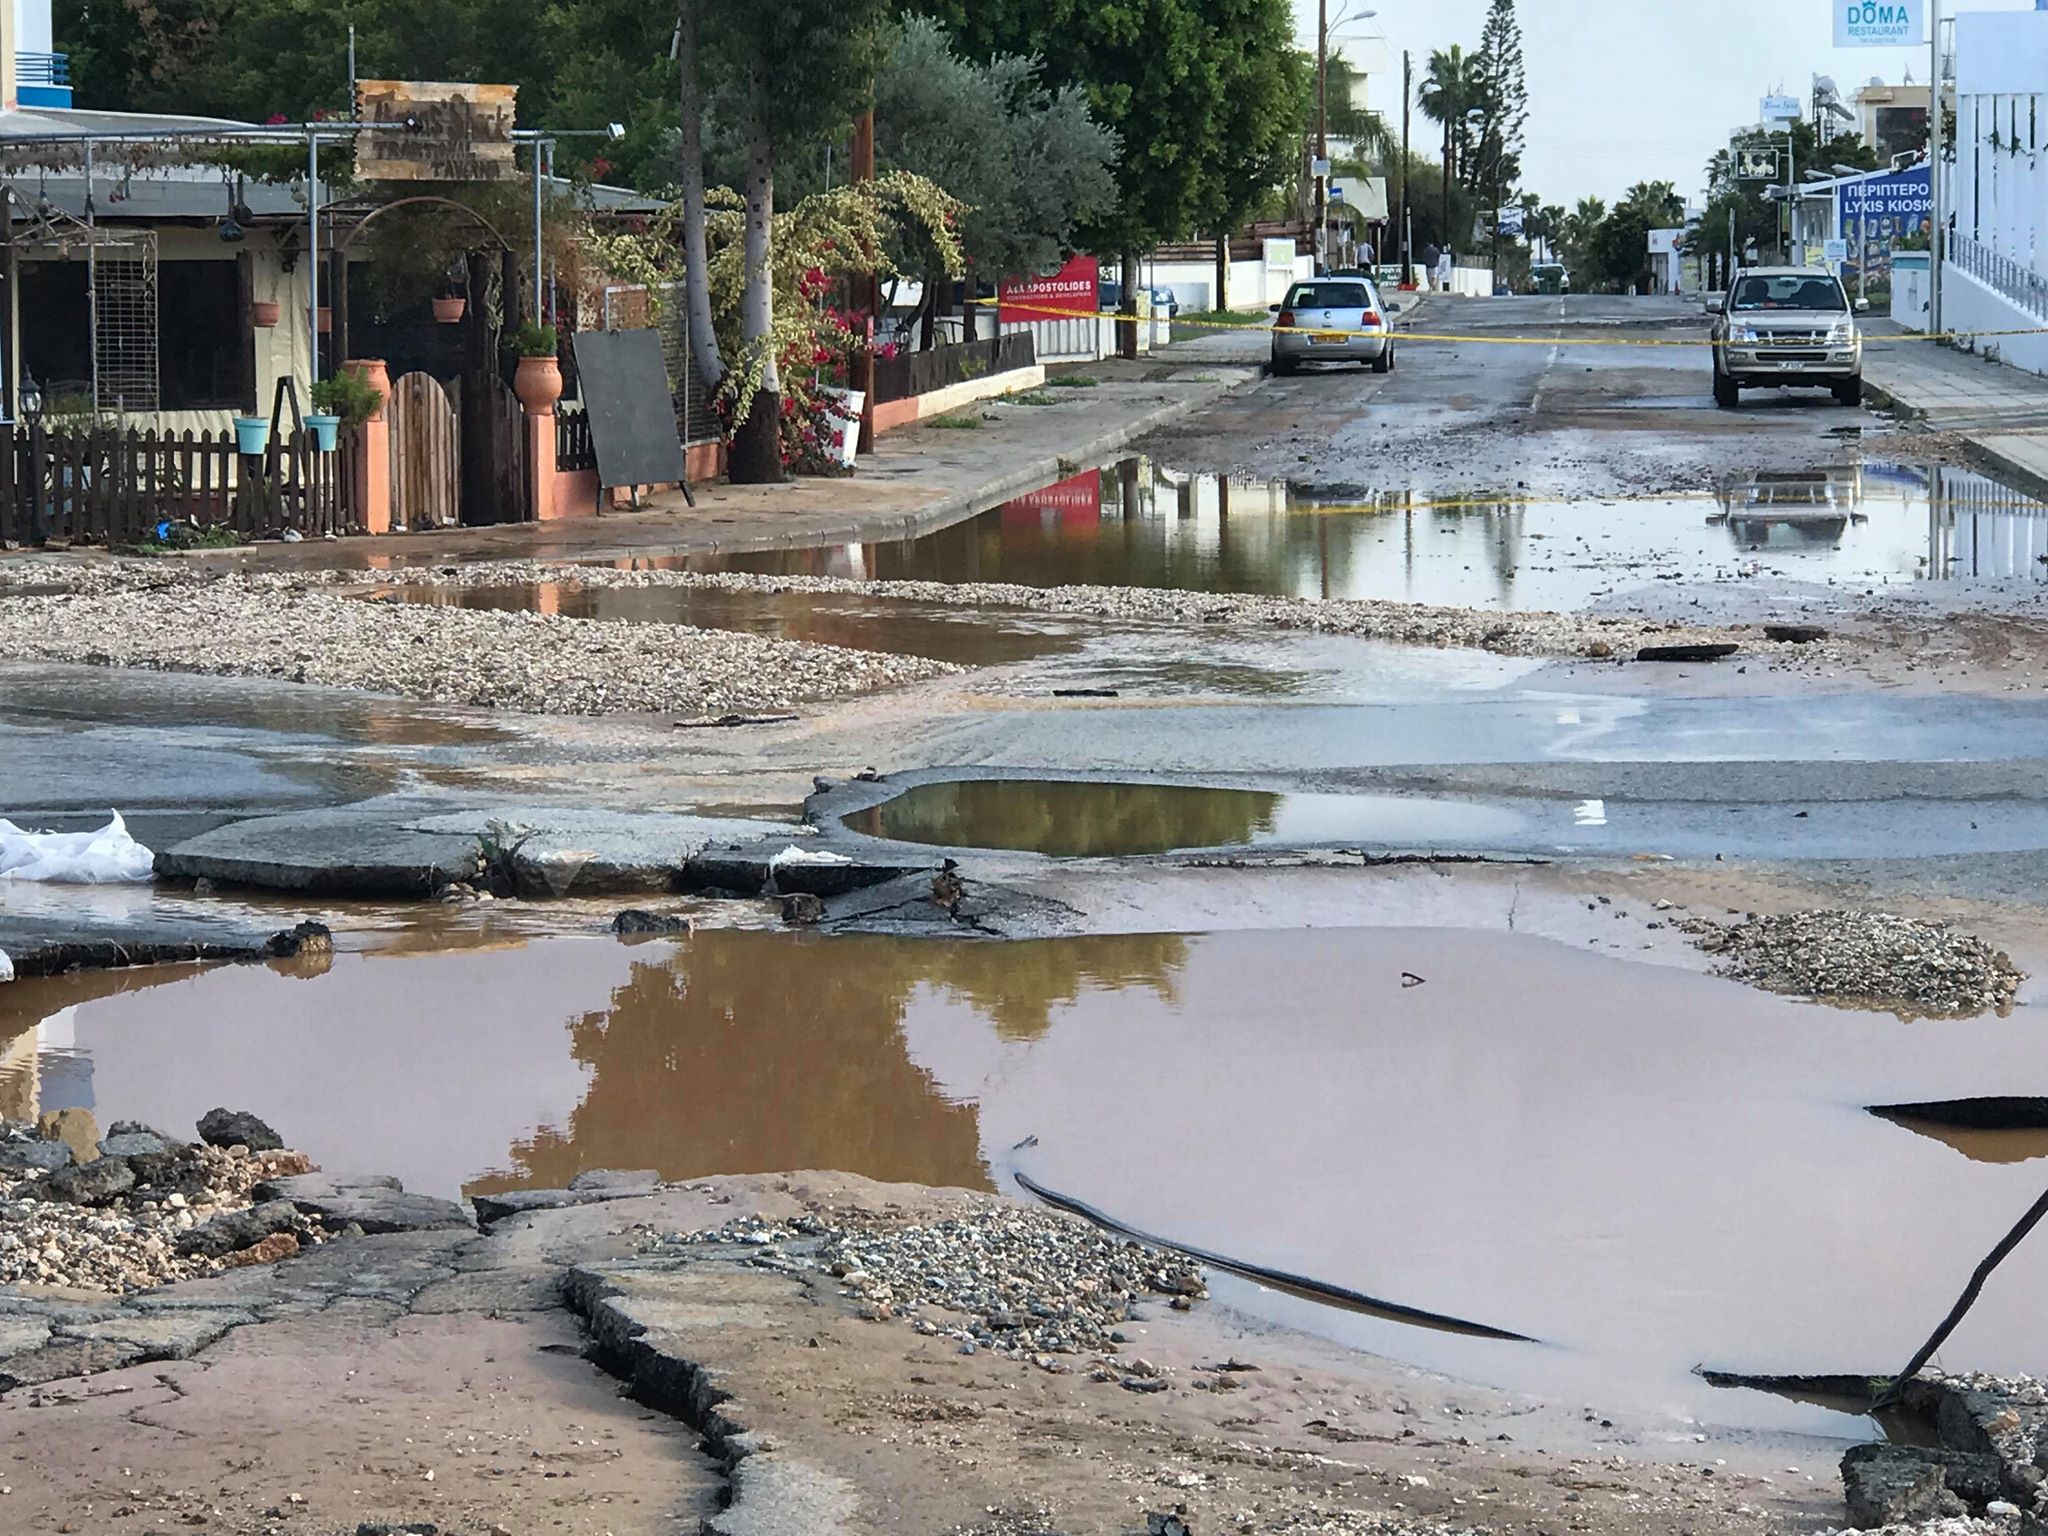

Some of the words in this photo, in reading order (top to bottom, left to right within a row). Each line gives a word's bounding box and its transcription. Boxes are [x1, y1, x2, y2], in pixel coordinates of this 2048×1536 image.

[1848, 6, 1909, 24] DOMA
[1848, 26, 1909, 37] RESTAURANT
[1888, 199, 1932, 212] KIOSK
[1027, 281, 1092, 293] APOSTOLIDES
